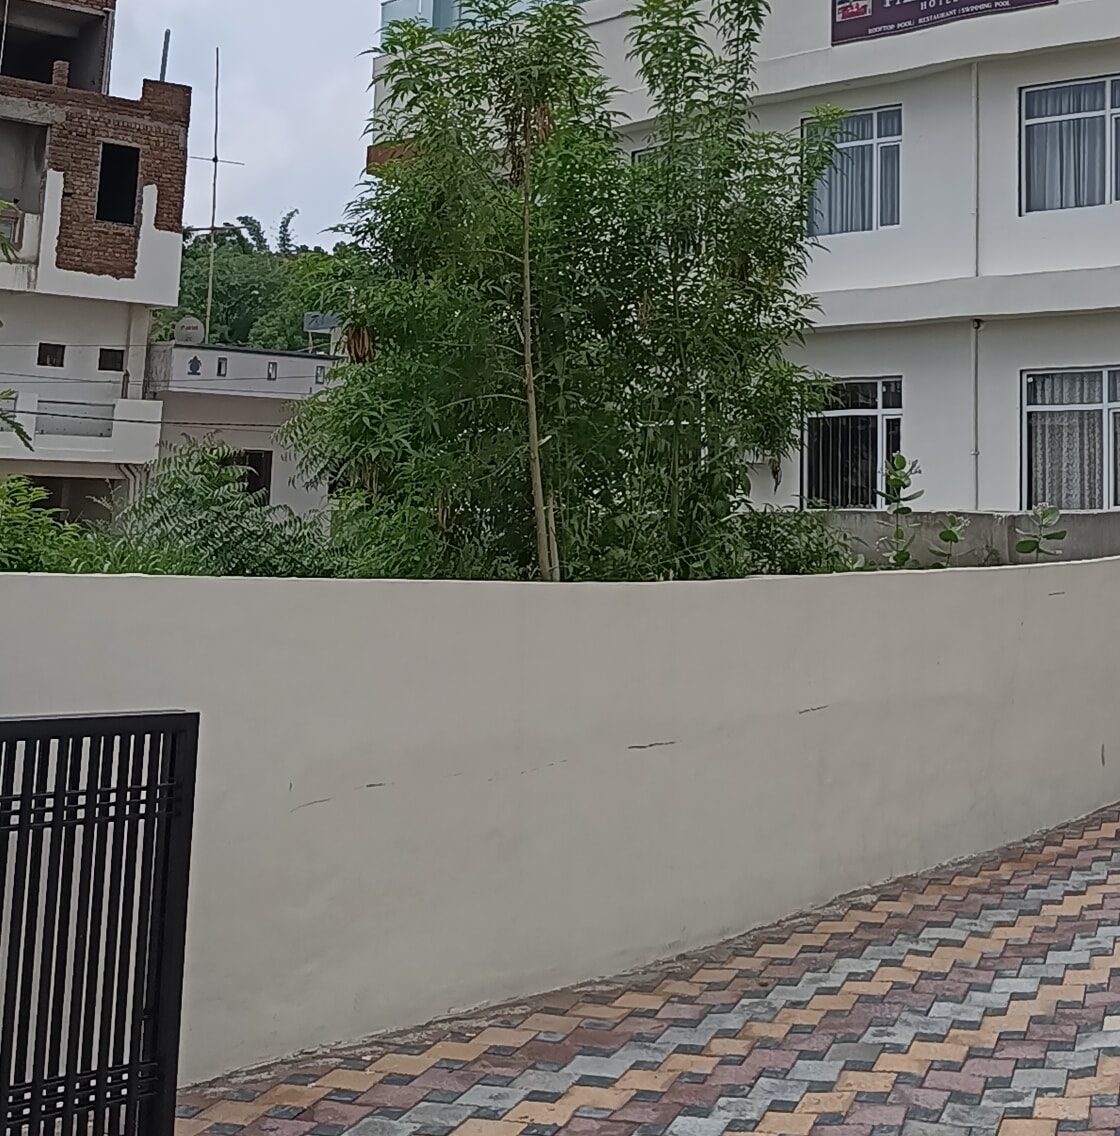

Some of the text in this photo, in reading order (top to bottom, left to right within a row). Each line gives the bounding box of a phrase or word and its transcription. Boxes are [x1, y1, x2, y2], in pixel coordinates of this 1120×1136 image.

[868, 24, 895, 34] ROOFTOP
[918, 9, 957, 23] RESTAURANT
[994, 0, 1011, 8] POOL
